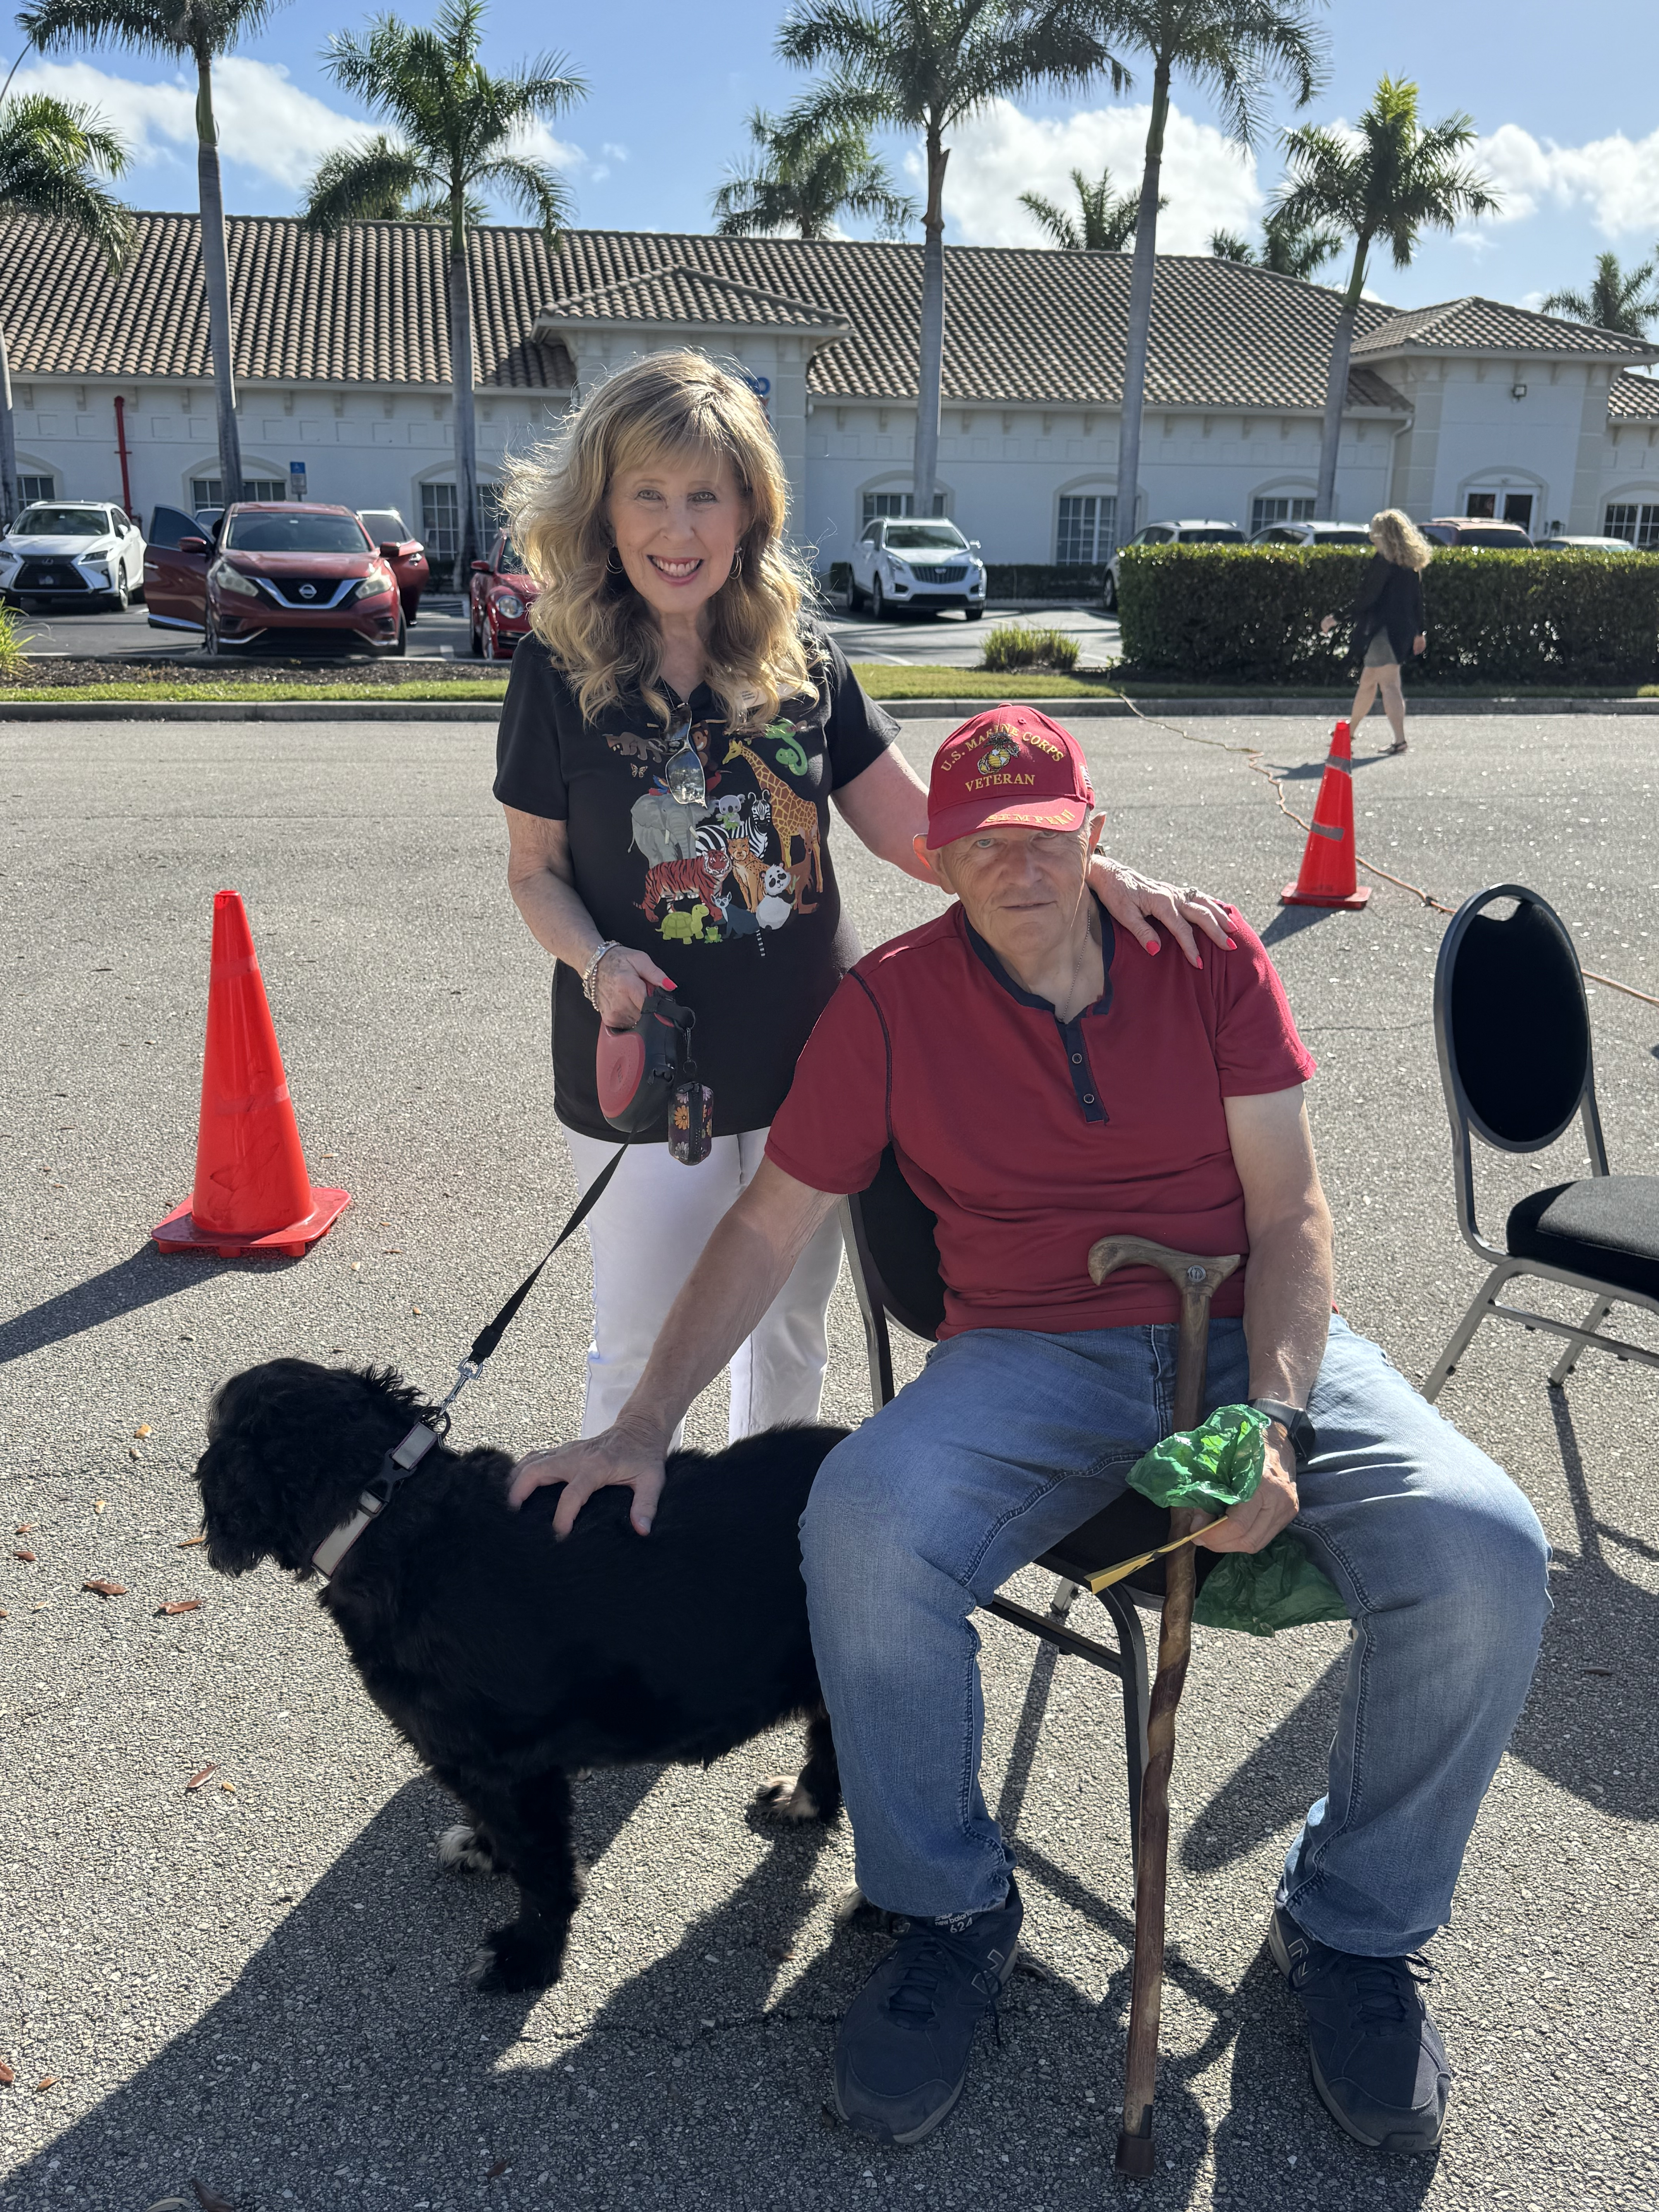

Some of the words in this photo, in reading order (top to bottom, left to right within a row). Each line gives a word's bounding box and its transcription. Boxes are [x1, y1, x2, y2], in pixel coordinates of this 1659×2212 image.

[941, 751, 965, 771] U.S.
[965, 723, 1019, 752] MARINE
[1022, 732, 1064, 761] CORPS
[965, 774, 1035, 792] VETERAN
[985, 814, 1069, 825] SEMPER
[949, 1910, 972, 1924] balan
[950, 1917, 973, 1933] 624
